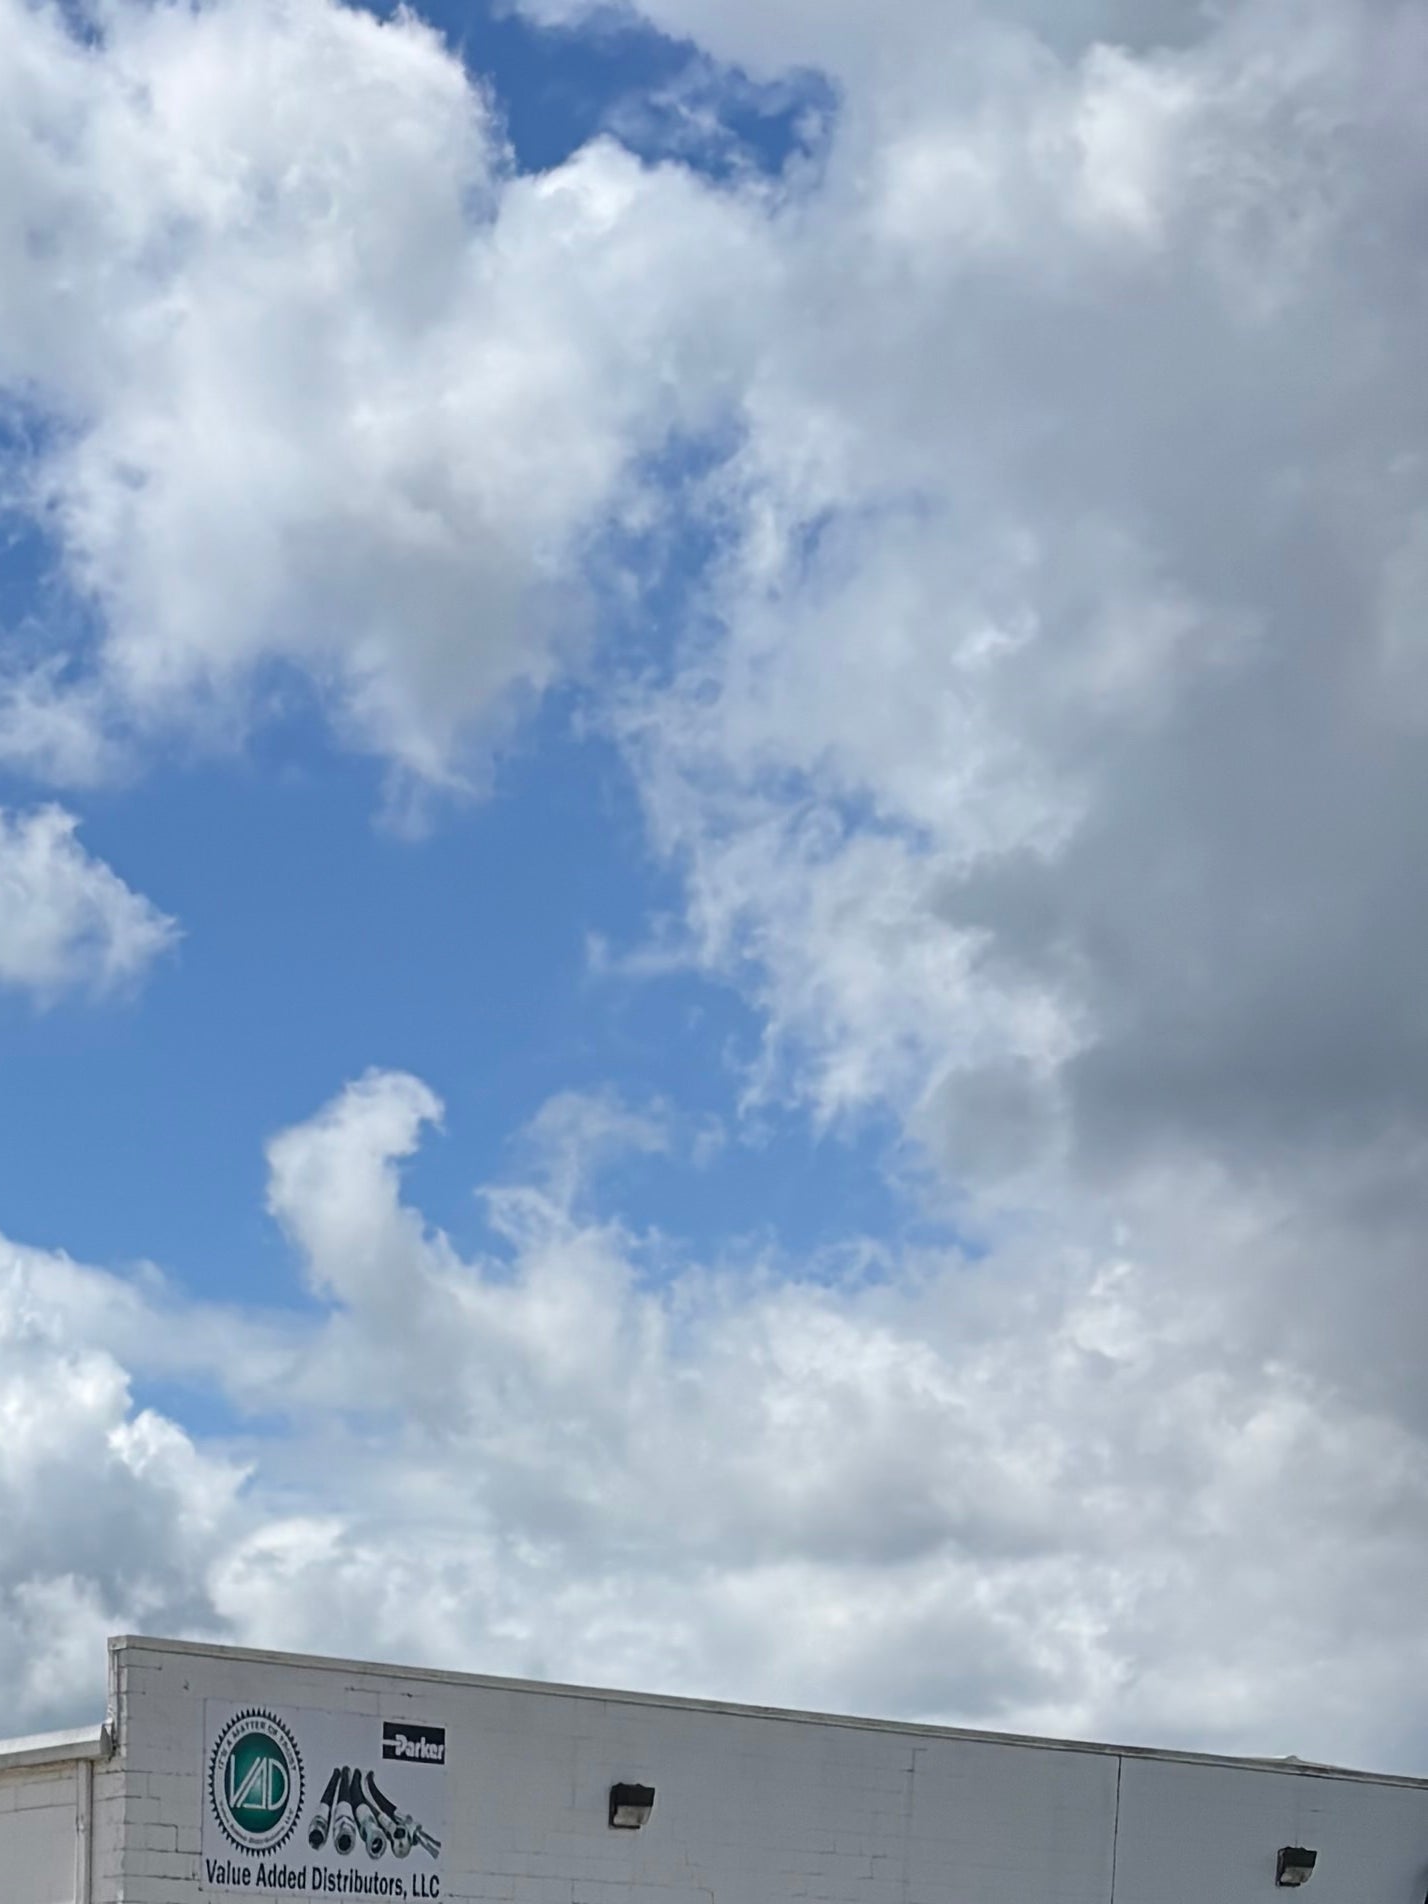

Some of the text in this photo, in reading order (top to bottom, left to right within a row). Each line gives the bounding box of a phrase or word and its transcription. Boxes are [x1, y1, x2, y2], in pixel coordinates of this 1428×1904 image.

[394, 1733, 445, 1760] Parker
[206, 1859, 440, 1899] Value Added Distributors, LLC
